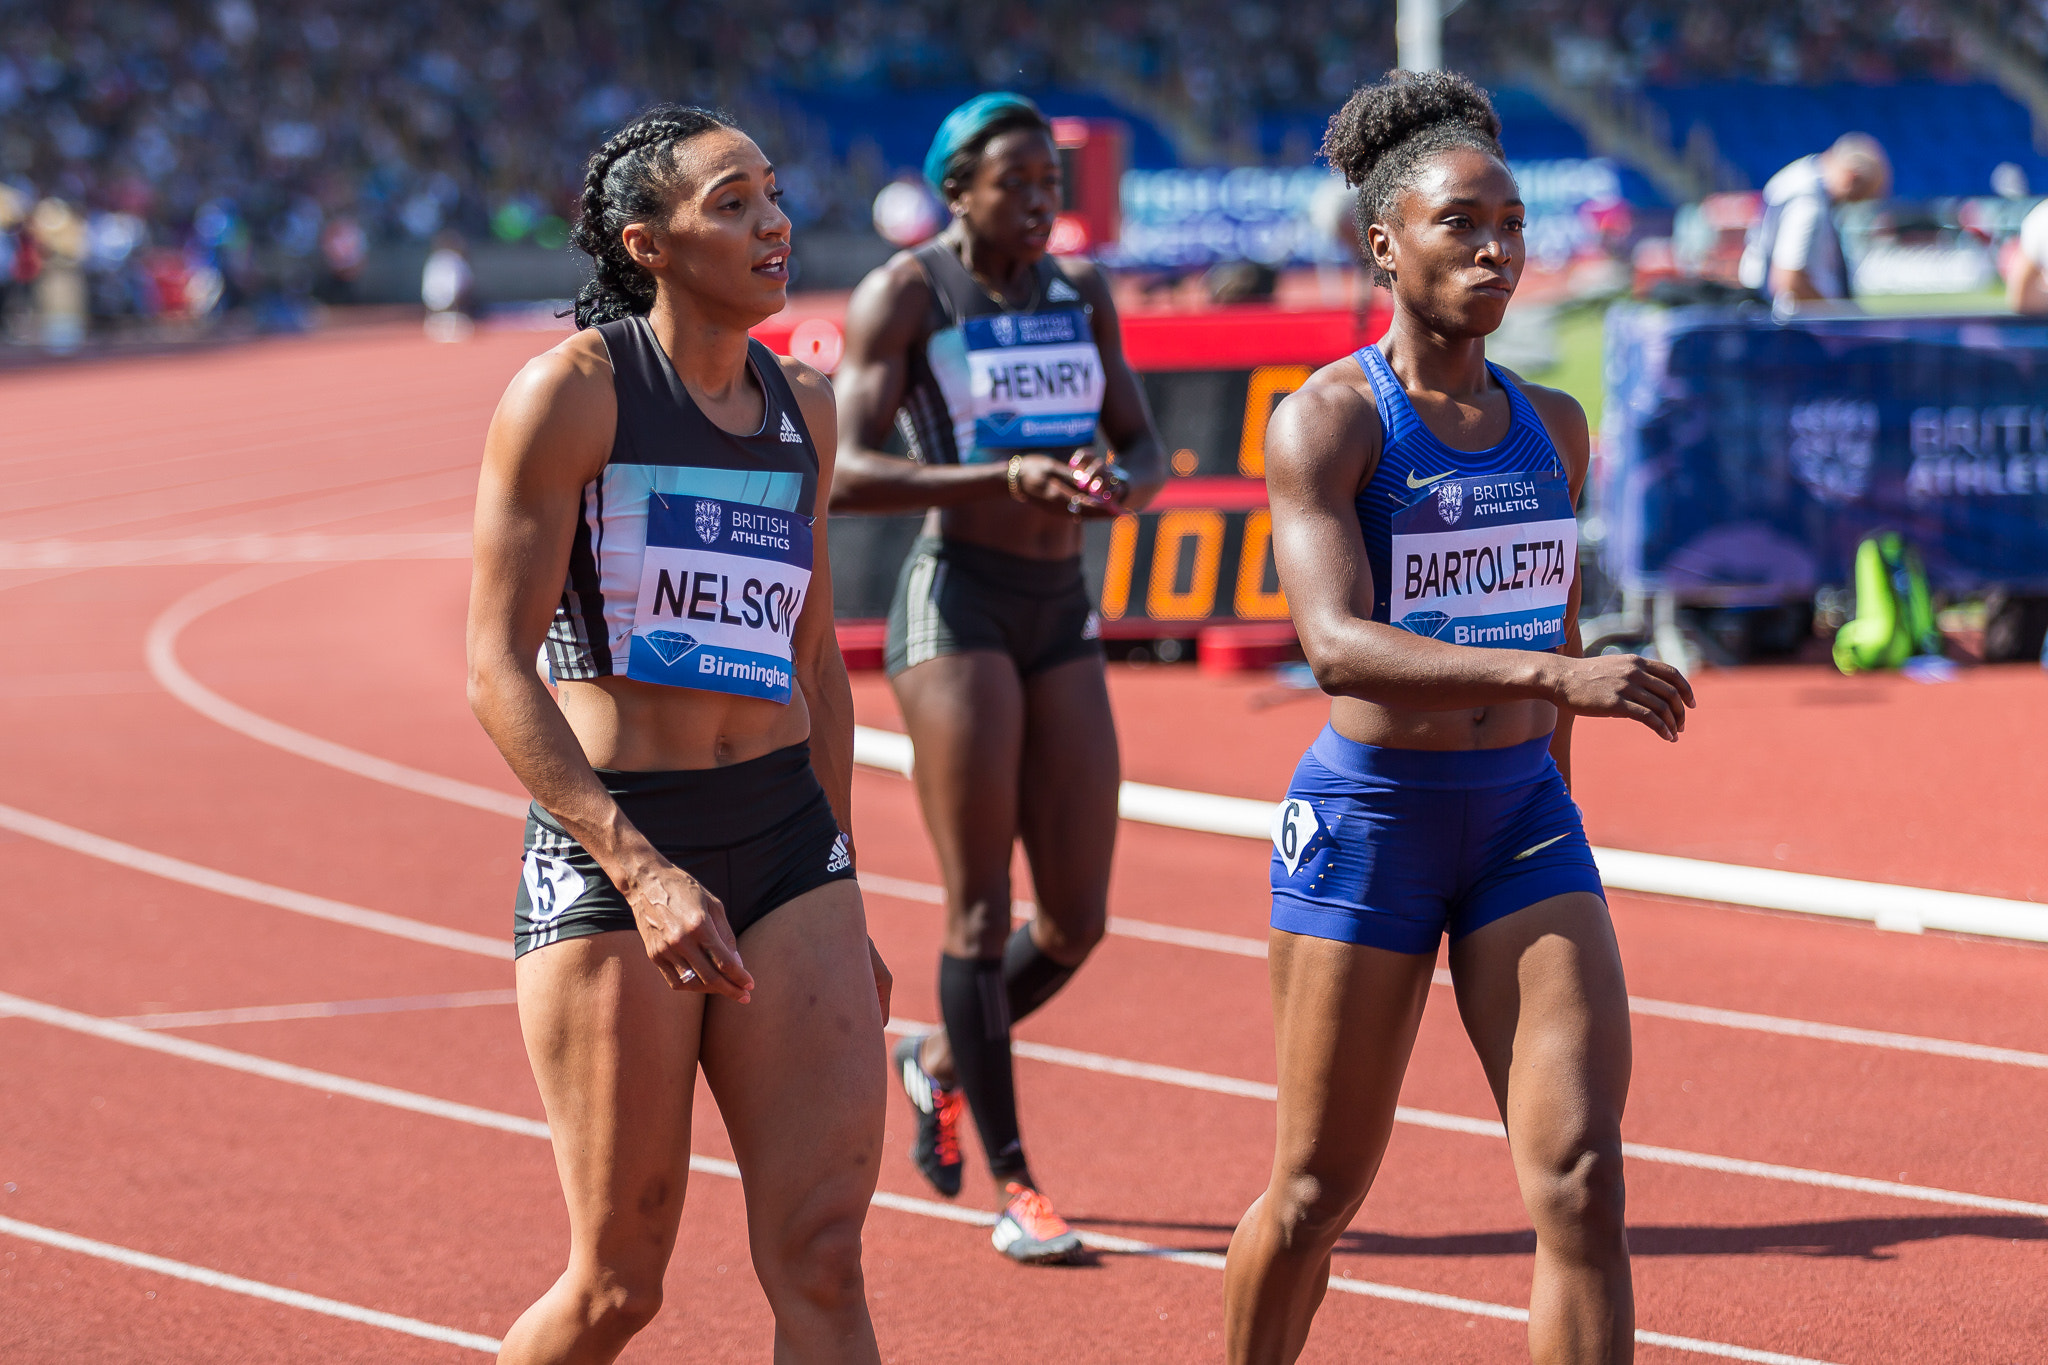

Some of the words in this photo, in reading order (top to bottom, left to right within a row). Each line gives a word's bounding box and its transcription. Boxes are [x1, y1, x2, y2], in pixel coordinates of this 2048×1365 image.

[989, 361, 1093, 400] HENRY
[780, 430, 802, 443] adidas
[1473, 481, 1536, 501] BRITISH
[1474, 498, 1539, 516] ATHLETICS
[732, 511, 789, 535] BRITISH
[730, 530, 790, 550] ATHLETICS
[1404, 540, 1565, 600] BARTOLETTA
[653, 569, 801, 637] NELSON
[1454, 617, 1561, 644] Birmingham
[1282, 801, 1300, 860] 6
[827, 854, 851, 872] adid
[534, 856, 556, 916] 5
